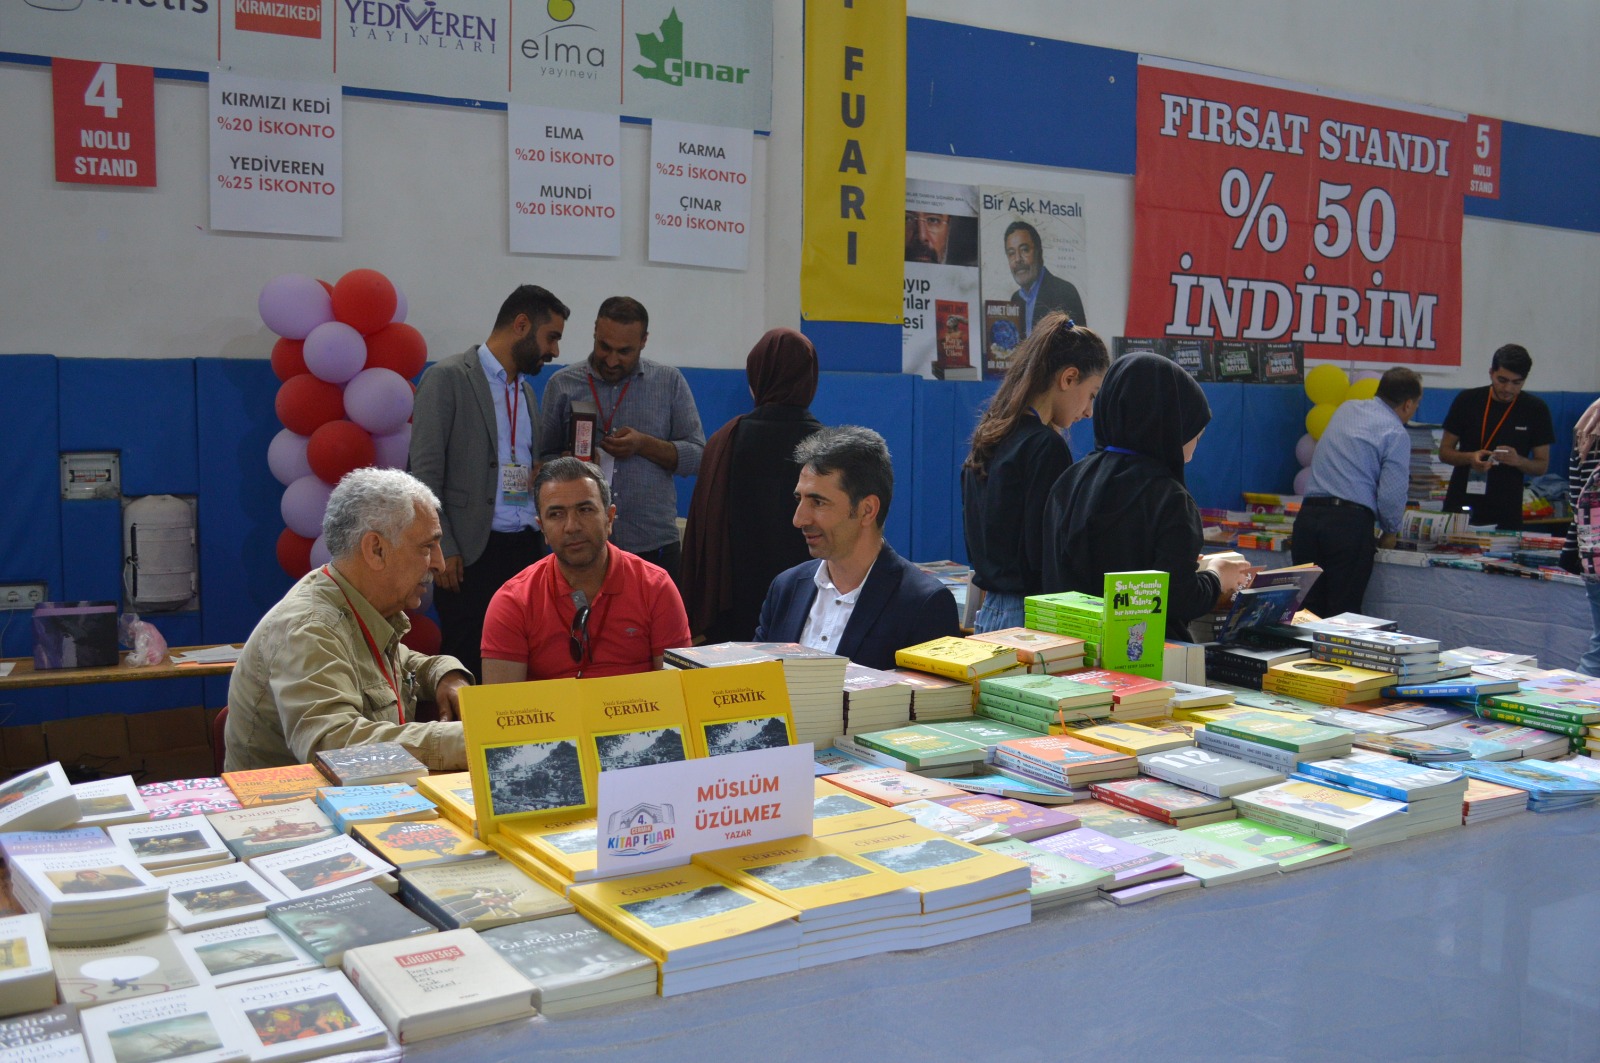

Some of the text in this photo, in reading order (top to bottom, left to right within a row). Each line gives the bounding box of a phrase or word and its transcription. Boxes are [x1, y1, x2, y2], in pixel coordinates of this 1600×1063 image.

[350, 25, 496, 54] YAYINLARI
[521, 34, 605, 68] elma
[540, 64, 598, 80] yayınevi
[664, 57, 750, 84] çınar
[84, 62, 123, 119] 4
[222, 91, 331, 115] KIRMIZI KEDİ
[217, 116, 335, 139] %20 İSKONTO
[545, 125, 584, 141] ELMA
[1160, 92, 1450, 178] FIRSAT STANDI
[80, 129, 130, 150] NOLU
[1476, 123, 1491, 159] 5
[515, 147, 615, 167] %20 İSKONTO
[678, 142, 726, 160] KARMA
[838, 45, 866, 266] FUARI
[75, 156, 138, 178] STAND
[229, 155, 324, 176] YEDİVEREN
[656, 163, 747, 185] %25 İSKONTO
[1473, 164, 1492, 177] NOLU
[217, 174, 335, 196] %25 İSKONTO
[539, 184, 592, 200] MUNDİ
[1470, 179, 1493, 194] STAND
[515, 200, 615, 218] %20 İSKONTO
[679, 196, 722, 213] ÇINAR
[983, 194, 1003, 212] Bir
[1007, 197, 1036, 217] Aşk
[1039, 200, 1083, 219] Masalı
[1219, 167, 1397, 263] % 50
[654, 213, 745, 234] %20 İSKONTO
[1164, 252, 1438, 350] İNDİRİM
[1115, 580, 1127, 592] Şu
[1113, 593, 1129, 609] fil
[1151, 596, 1162, 614] 2
[604, 700, 660, 719] ÇERMİK
[713, 690, 766, 709] ÇERMİK
[496, 710, 556, 730] ÇERMİK
[1149, 750, 1220, 768] 112
[697, 775, 780, 803] MÜSLÜM
[694, 802, 782, 831] ÜZÜLMEZ
[607, 827, 675, 849] KİTAP FUARI
[724, 829, 752, 841] YAZAR
[854, 832, 911, 848] ÇERMİK
[742, 848, 804, 863] ÇERMİK
[620, 880, 688, 896] ÇERMİK
[499, 927, 599, 950] GERGEDAN
